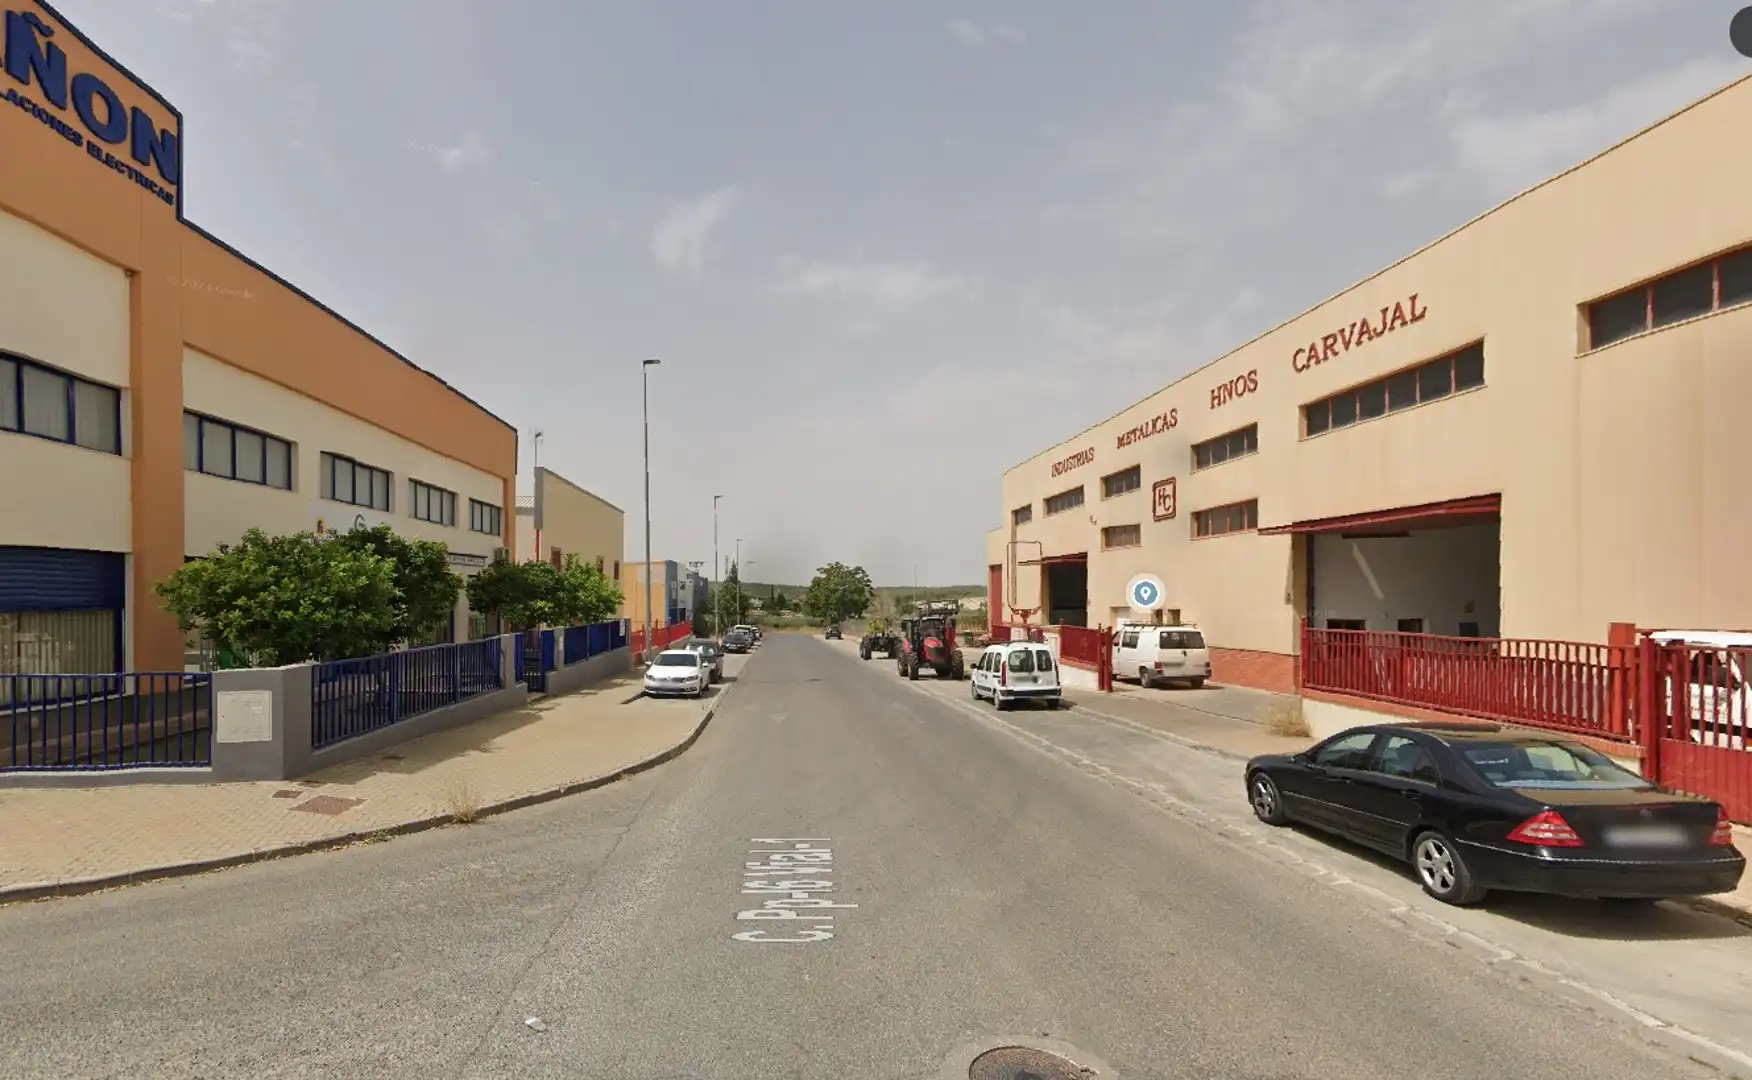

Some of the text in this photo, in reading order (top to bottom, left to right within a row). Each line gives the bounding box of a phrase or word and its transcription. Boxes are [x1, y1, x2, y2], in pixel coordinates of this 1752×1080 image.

[0, 10, 178, 185] ÑON
[87, 140, 174, 205] ELECTRICAS
[1051, 292, 1428, 478] INDUSTRIAS METALICAS HNOS CARVAJAL
